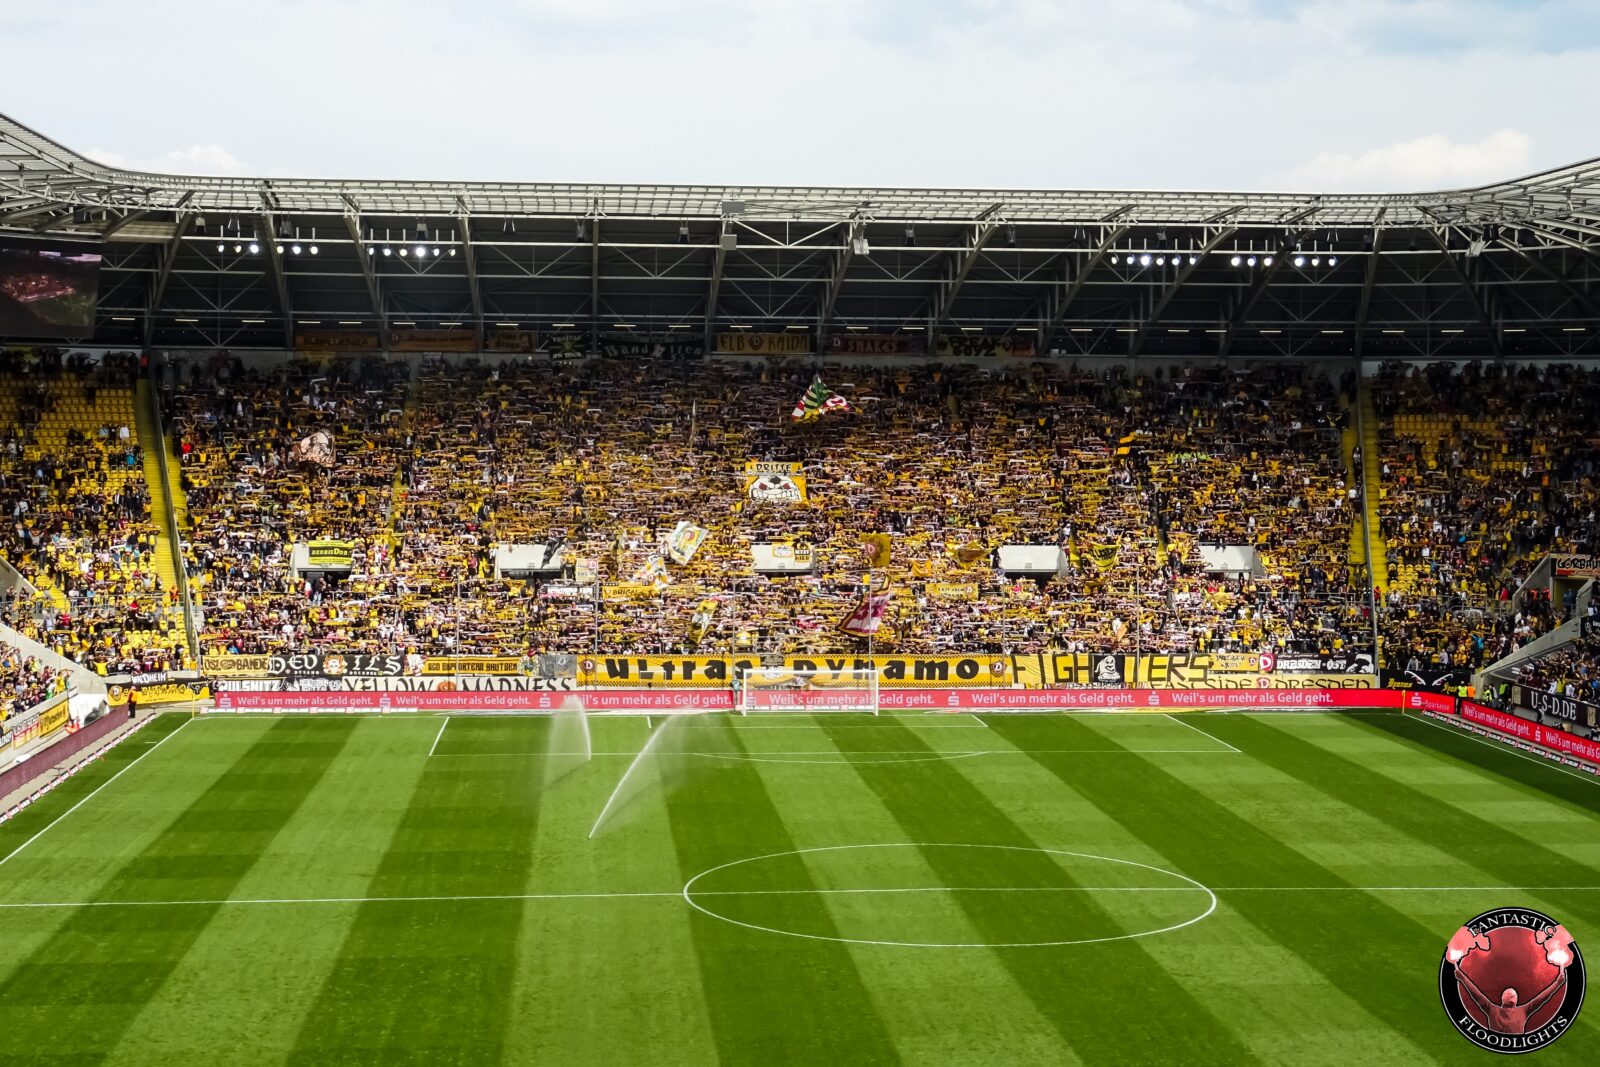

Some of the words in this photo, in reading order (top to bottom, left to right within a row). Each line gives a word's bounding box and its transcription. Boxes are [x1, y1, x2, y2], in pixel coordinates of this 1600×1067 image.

[237, 695, 265, 705] Weil's
[285, 696, 310, 705] mehr
[311, 696, 324, 705] als
[327, 696, 347, 705] Geld
[350, 696, 373, 707] geht.
[395, 696, 424, 705] Weil's
[443, 696, 467, 705] mehr
[469, 696, 482, 705] als
[484, 696, 505, 705] Geld
[507, 696, 531, 707] geht.
[601, 697, 619, 705] um
[622, 695, 653, 705] mehr
[655, 695, 671, 705] als
[674, 695, 700, 705] Geld
[702, 695, 732, 708] geht.
[827, 694, 857, 704] mehr
[880, 693, 902, 704] Geld
[905, 693, 935, 707] geht.
[971, 693, 1005, 703] Weil's
[1008, 695, 1026, 703] um
[1029, 693, 1058, 703] mehr
[1060, 693, 1076, 703] als
[1079, 693, 1104, 703] Geld
[1106, 693, 1136, 705] geht.
[1171, 692, 1205, 702] Weil's
[1228, 692, 1257, 702] mehr
[1259, 692, 1275, 702] als
[1278, 692, 1302, 702] Geld
[1305, 692, 1333, 705] geht.
[1464, 705, 1477, 718] Weil's
[1478, 711, 1485, 720] um
[1486, 713, 1497, 724] mehr
[1506, 718, 1516, 731] Geld
[1546, 731, 1561, 746] Weil's
[1562, 739, 1571, 750] um
[1572, 741, 1586, 754] mehr
[1587, 744, 1595, 757] als
